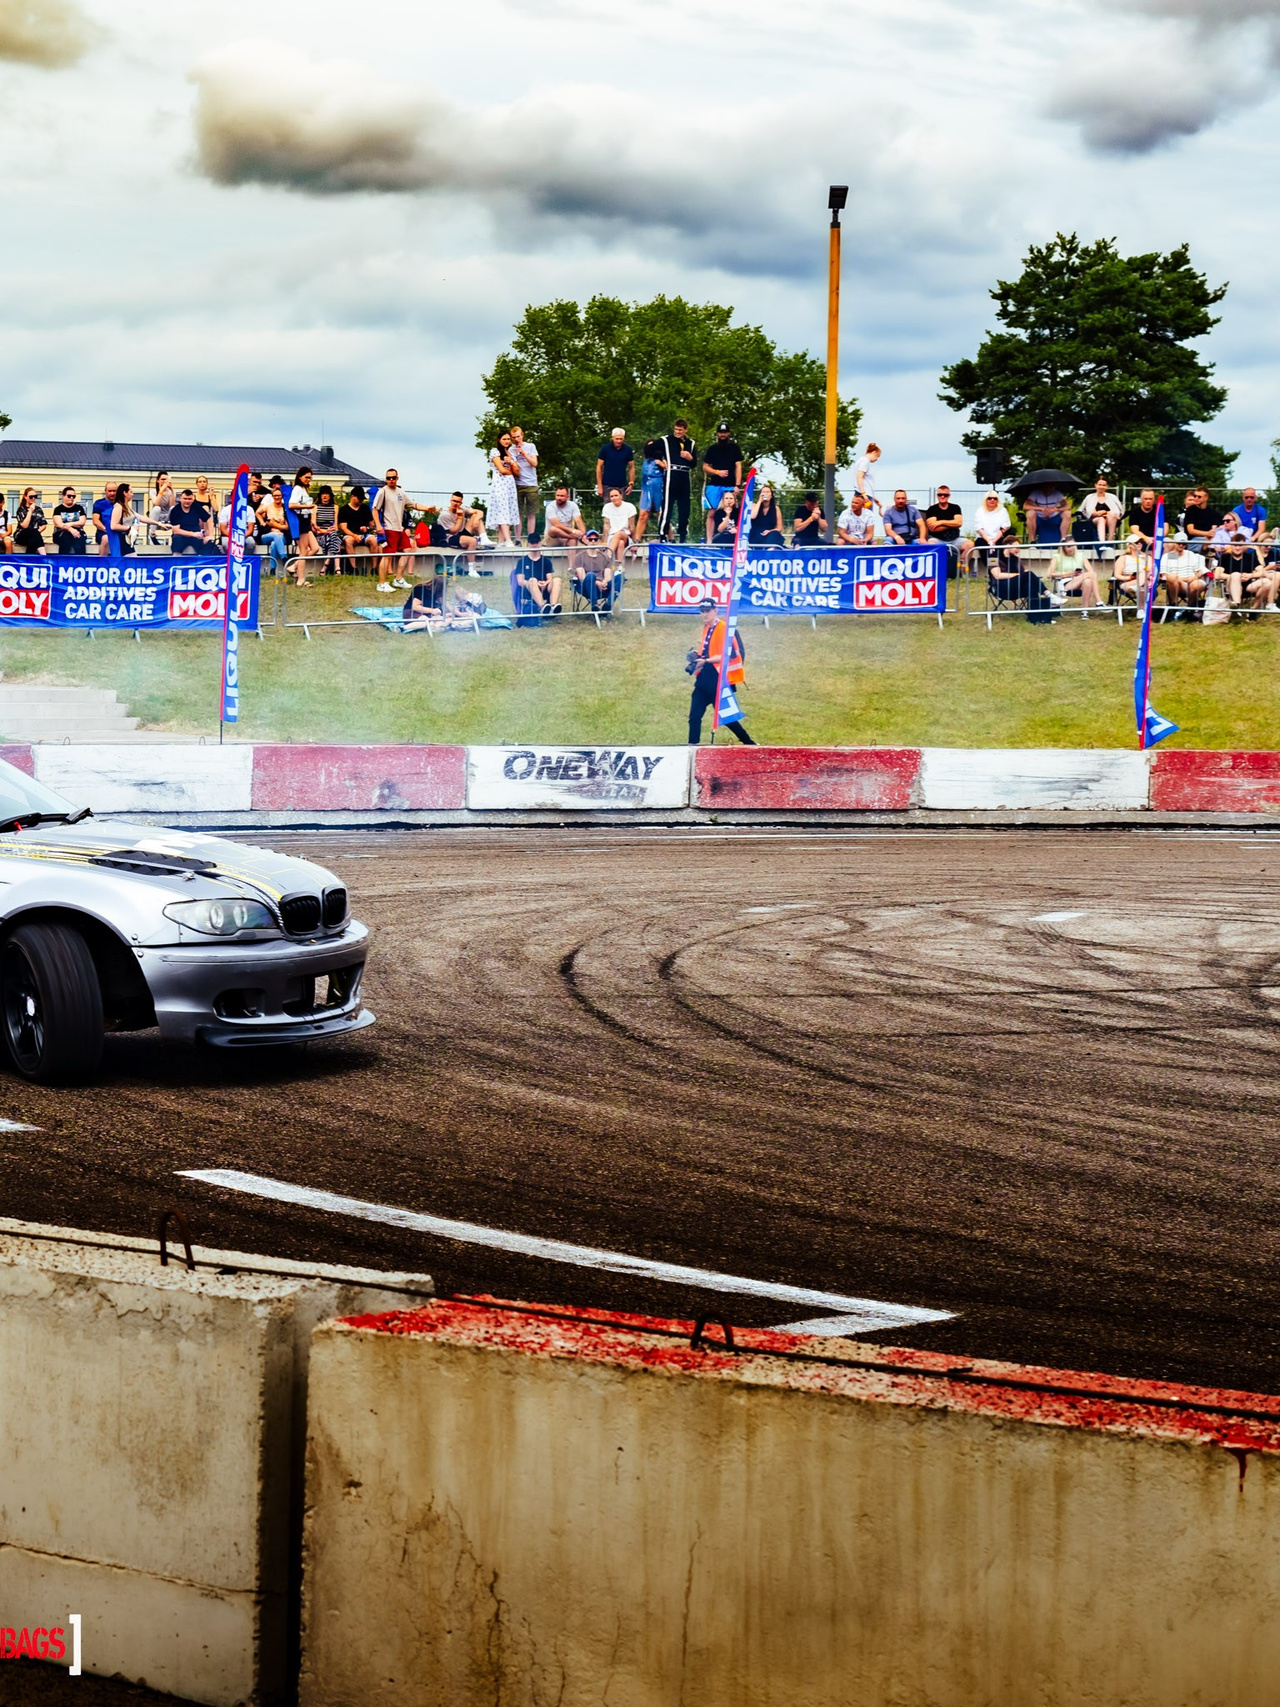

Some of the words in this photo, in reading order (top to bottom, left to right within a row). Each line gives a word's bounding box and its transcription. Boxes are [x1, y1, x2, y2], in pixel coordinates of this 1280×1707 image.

[59, 567, 120, 584] MOTOR
[124, 567, 165, 584] OILS
[662, 556, 732, 579] LIQUI
[744, 558, 803, 576] MOTOR
[810, 558, 849, 575] OILS
[859, 557, 933, 582] LIQUI
[63, 586, 157, 601] ADDITIVES
[660, 580, 730, 603] MOLY
[749, 577, 842, 593] ADDITIVES
[858, 581, 935, 607] MOLY
[65, 602, 109, 619] CAR
[112, 603, 154, 620] CARE
